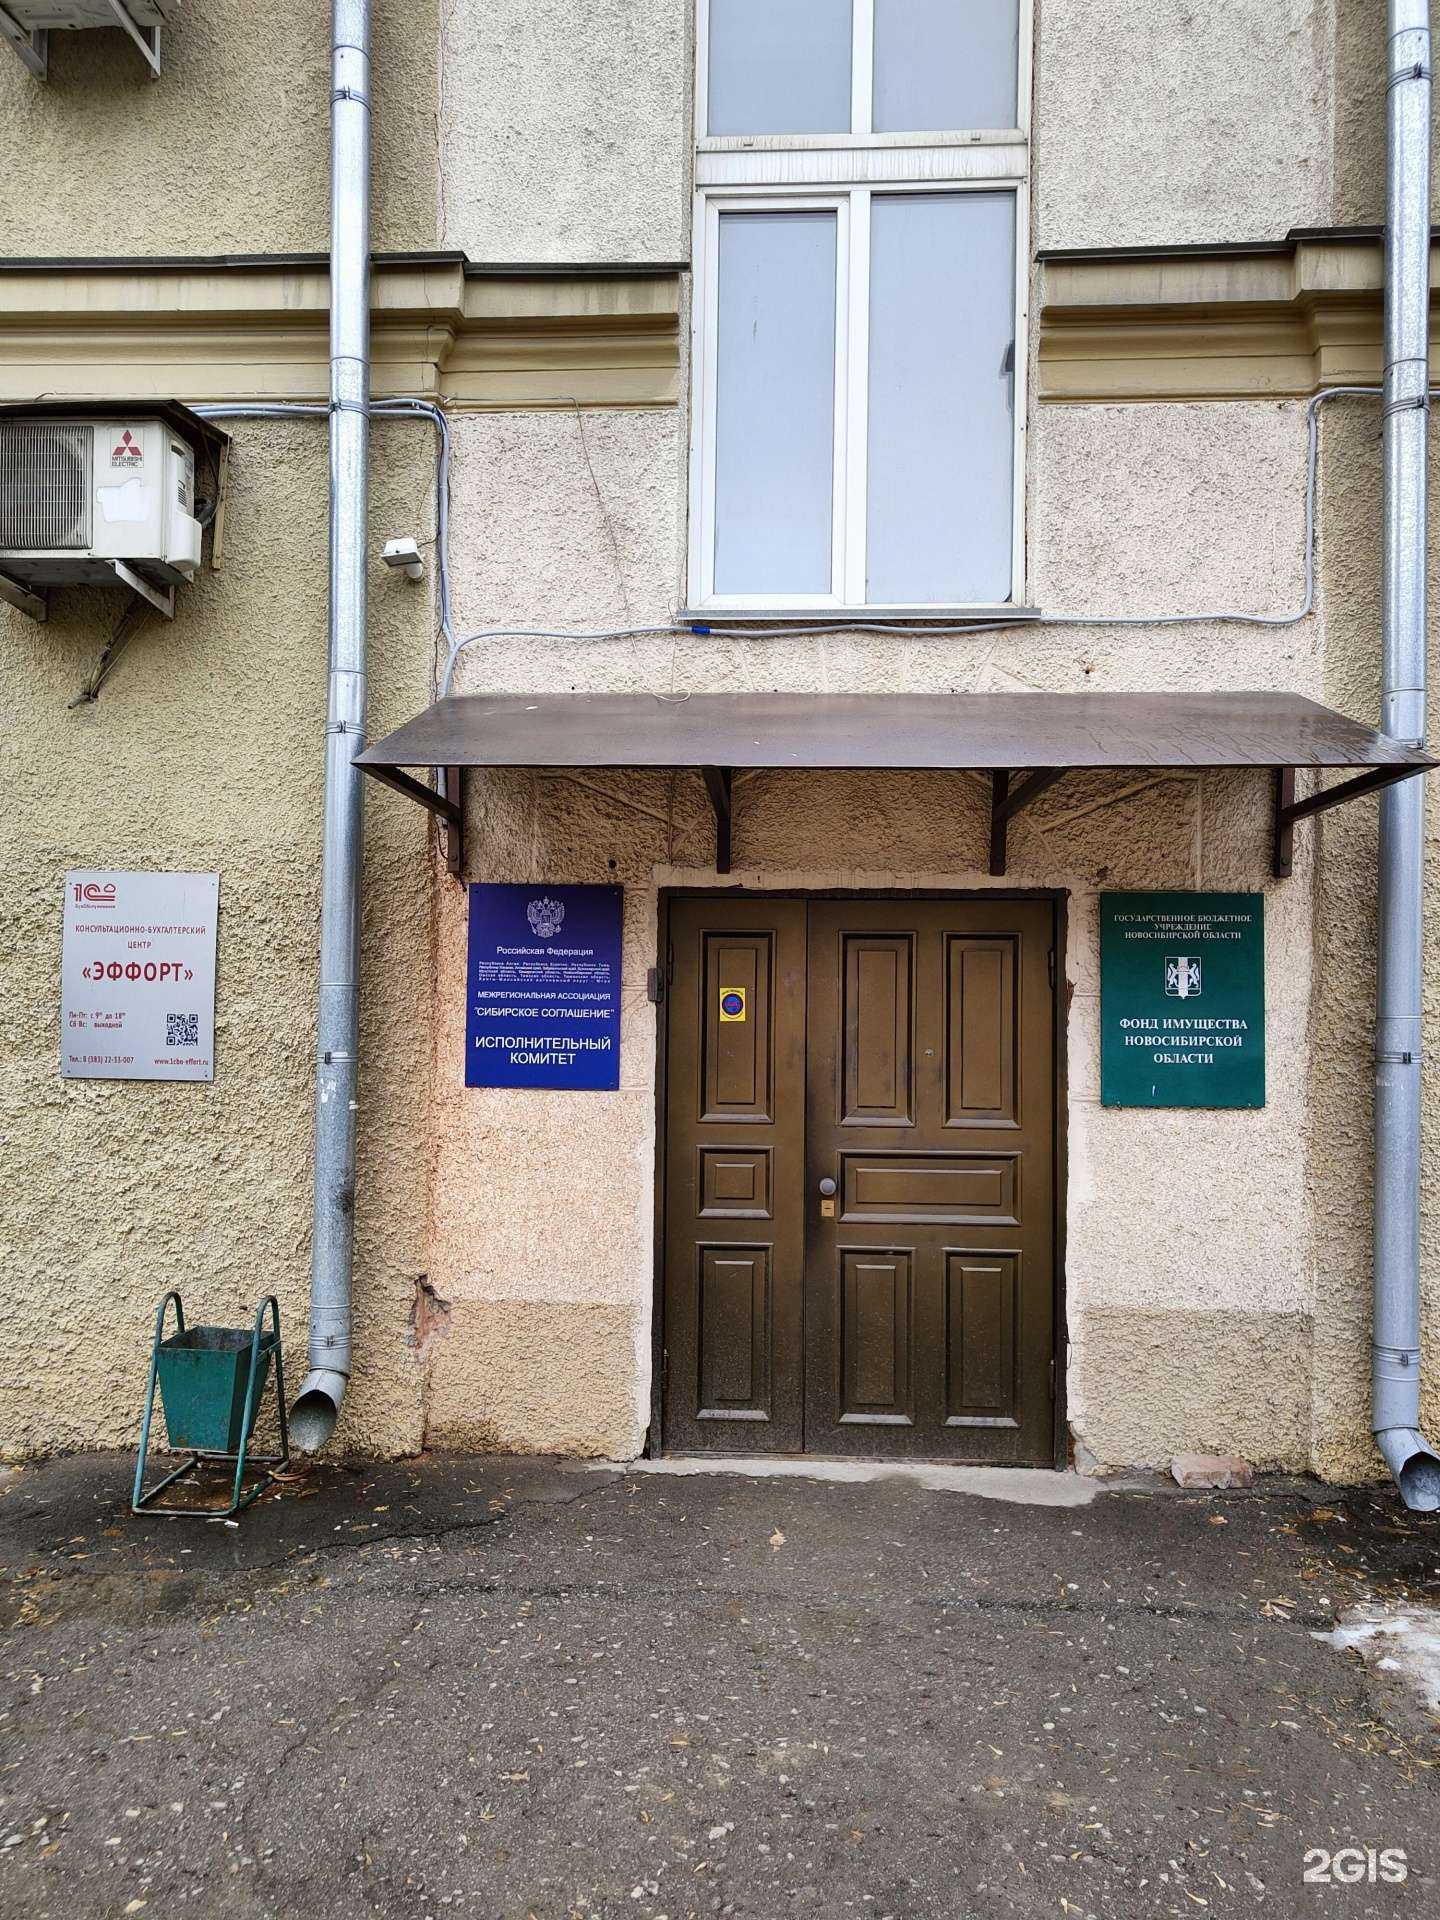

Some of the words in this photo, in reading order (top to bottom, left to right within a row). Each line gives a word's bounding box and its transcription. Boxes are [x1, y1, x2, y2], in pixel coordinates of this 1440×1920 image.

[1114, 914, 1196, 922] ГОСУДАРСТВЕННОЕ
[1198, 914, 1252, 922] БЮДЖЕТНОЕ
[75, 924, 206, 935] КОНСУЛЬТАЦИОННО-БУХГАЛТЕРСКИЙ
[1154, 923, 1212, 931] УЧРЕЖДЕНИЕ
[1125, 931, 1200, 939] НОВОСИБИРСКОЙ
[1202, 931, 1241, 939] ОБЛАСТИ
[127, 941, 152, 949] ЦЕНТР
[497, 946, 544, 955] Российская
[547, 947, 594, 957] Федерация
[82, 961, 194, 982] «ЭФФОРТ»
[477, 991, 556, 999] МЕЖРЕГИОНАЛЬНАЯ
[557, 992, 611, 1001] АССОЦИАЦИЯ
[1119, 1018, 1158, 1029] ФОНД
[1163, 1019, 1248, 1030] ИМУЩЕСТВА
[475, 1036, 611, 1050] ИСПОЛНИТЕЛЬНЫЙ
[1125, 1034, 1242, 1047] НОВОСИБИРСКОЙ
[510, 1052, 576, 1065] КОМИТЕТ
[1154, 1053, 1213, 1064] ОБЛАСТИ
